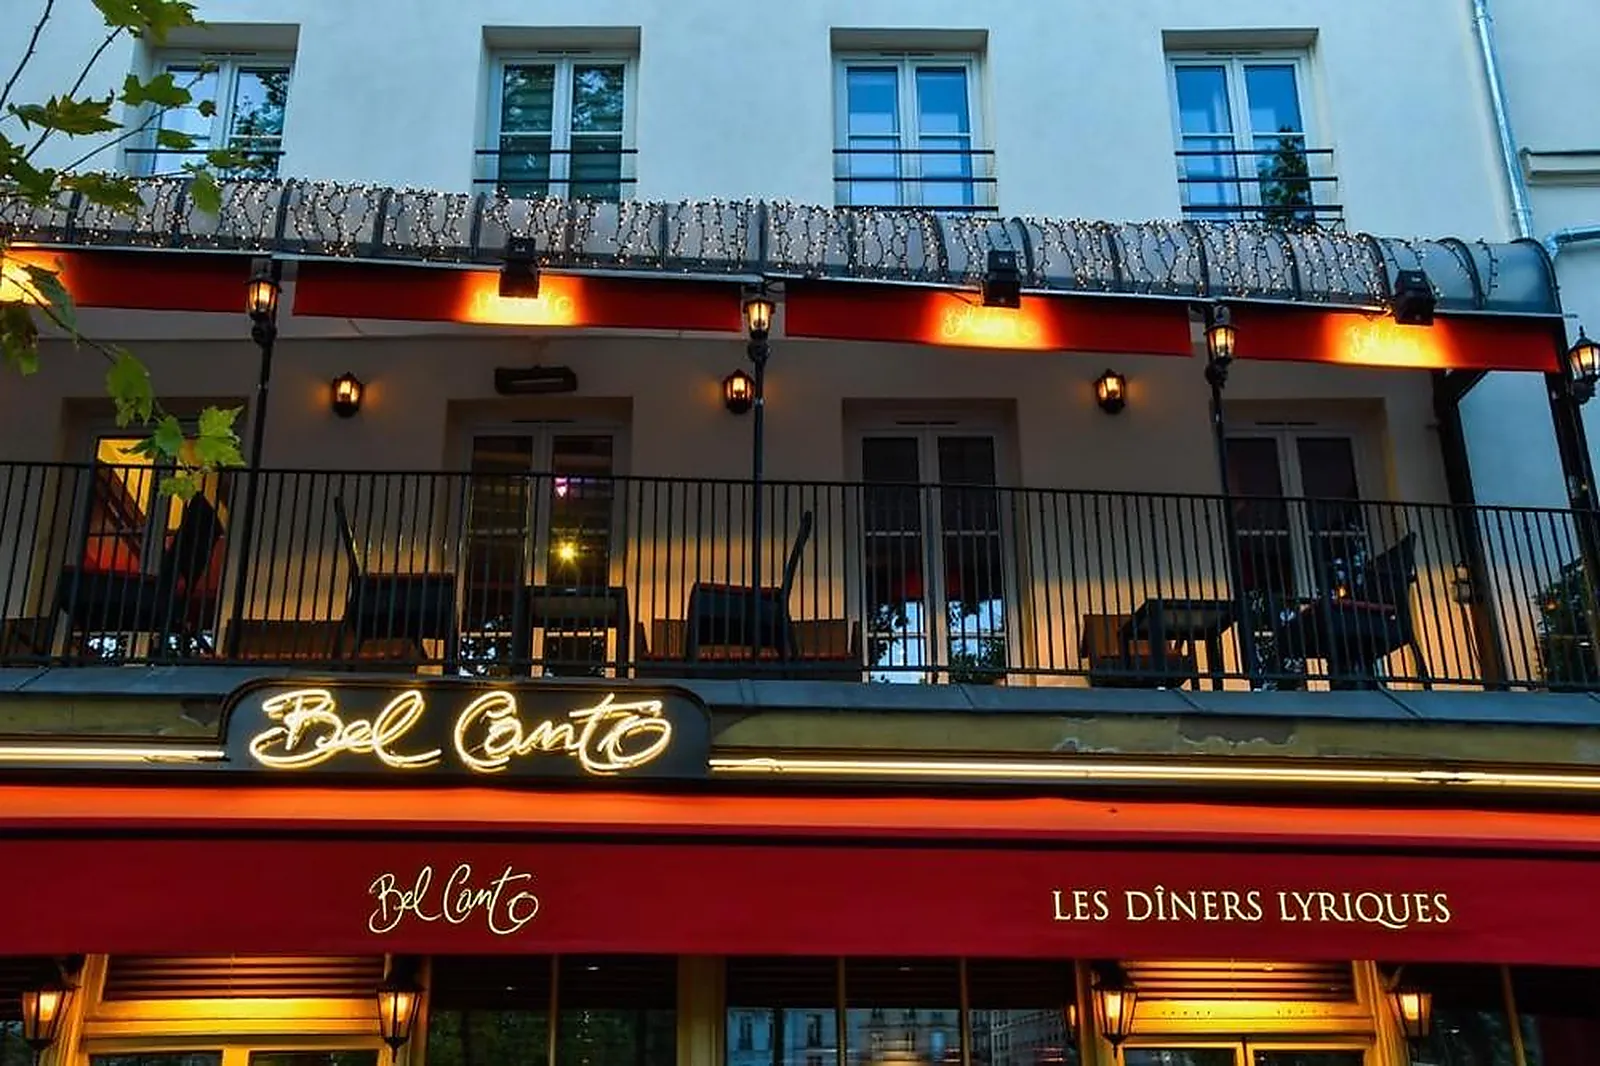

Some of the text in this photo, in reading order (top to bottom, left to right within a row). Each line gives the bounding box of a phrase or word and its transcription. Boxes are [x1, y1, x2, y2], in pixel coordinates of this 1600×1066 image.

[248, 688, 672, 776] Bel Canto
[368, 863, 539, 935] Bel Canto
[1052, 884, 1451, 930] LES DÎNERS LYRIQUES
